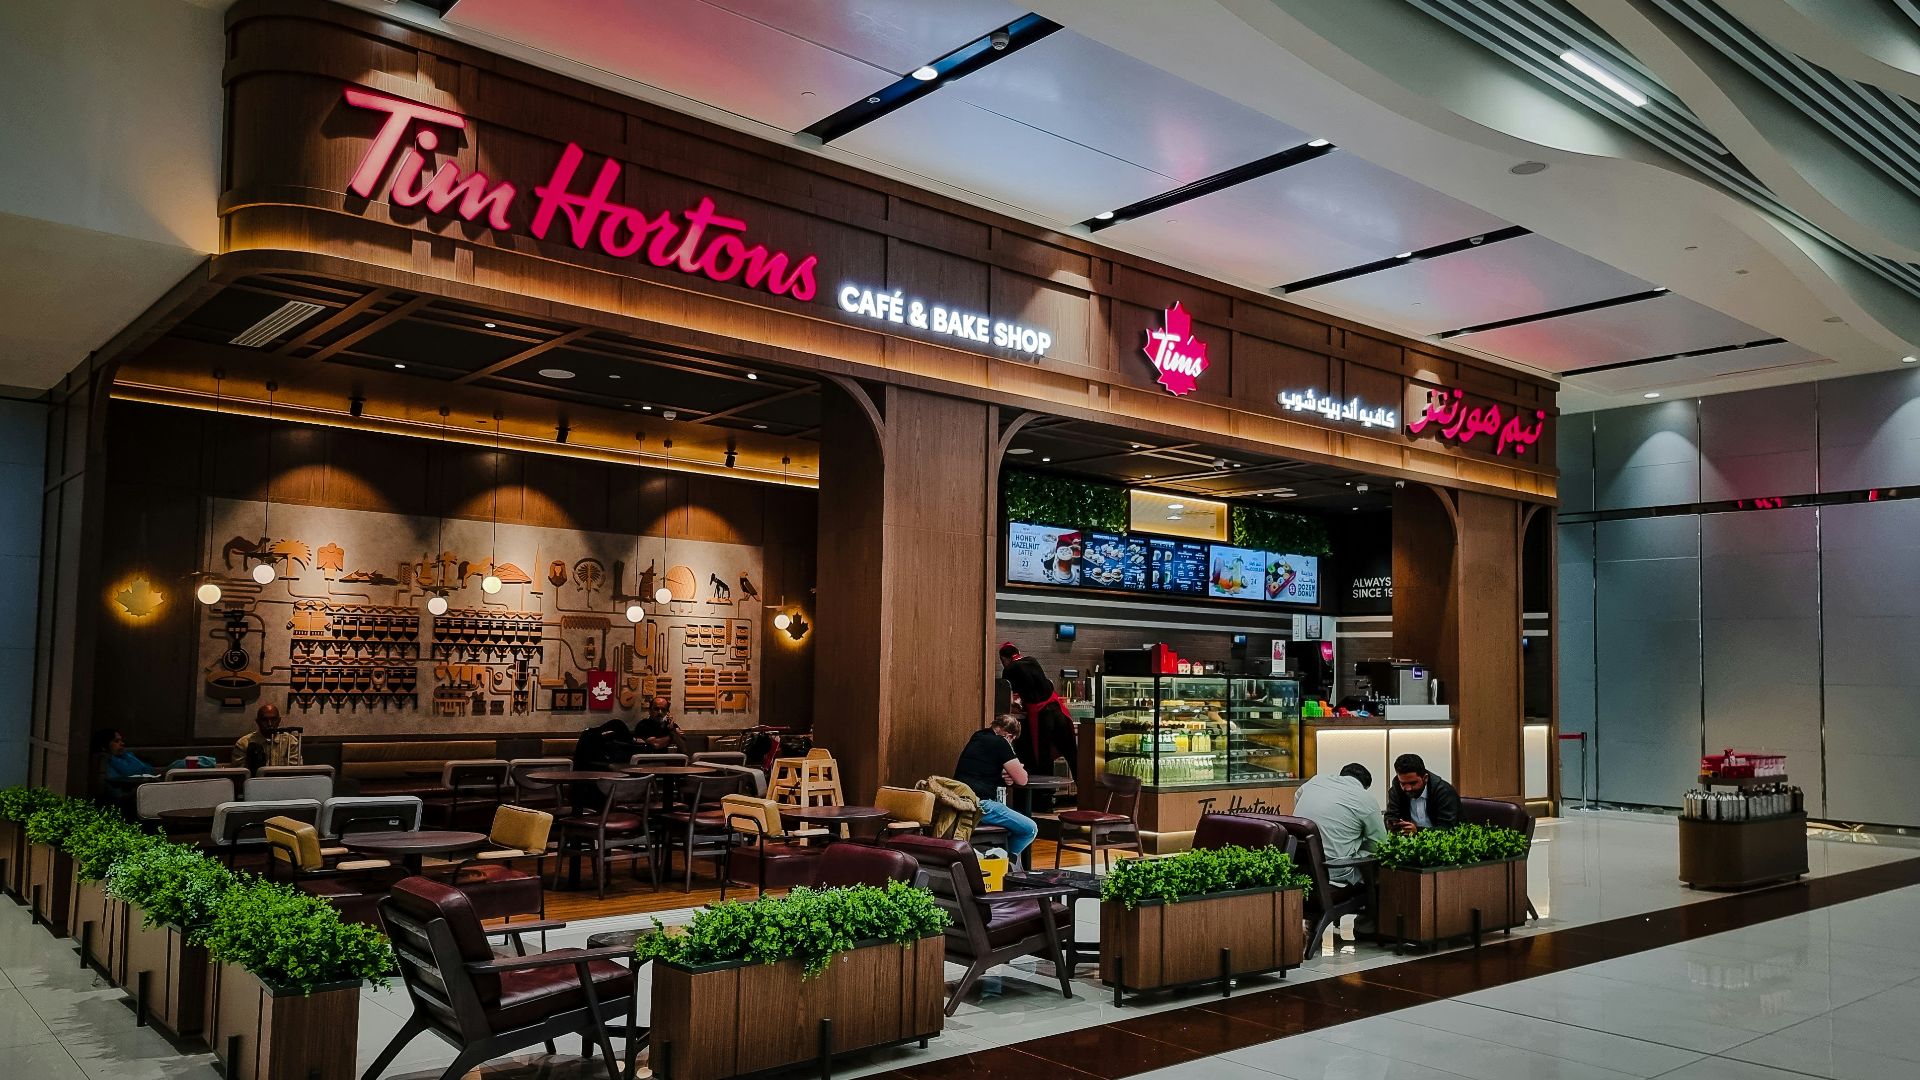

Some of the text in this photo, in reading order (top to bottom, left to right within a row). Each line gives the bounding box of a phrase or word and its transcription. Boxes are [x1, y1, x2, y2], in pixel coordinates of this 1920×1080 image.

[344, 87, 818, 300] Tim Hortons
[839, 286, 1052, 355] CAFÉ & BAKE SHOP
[1152, 332, 1202, 377] Tims
[1497, 409, 1546, 456] تيم
[1015, 533, 1037, 542] HONEY
[1011, 541, 1040, 550] HAZELNUT
[1018, 549, 1033, 557] LATTE
[1297, 583, 1316, 591] DOZEN
[1352, 577, 1391, 588] ALWAYS
[1352, 588, 1382, 598] SINCE
[1227, 795, 1281, 815] Hortons
